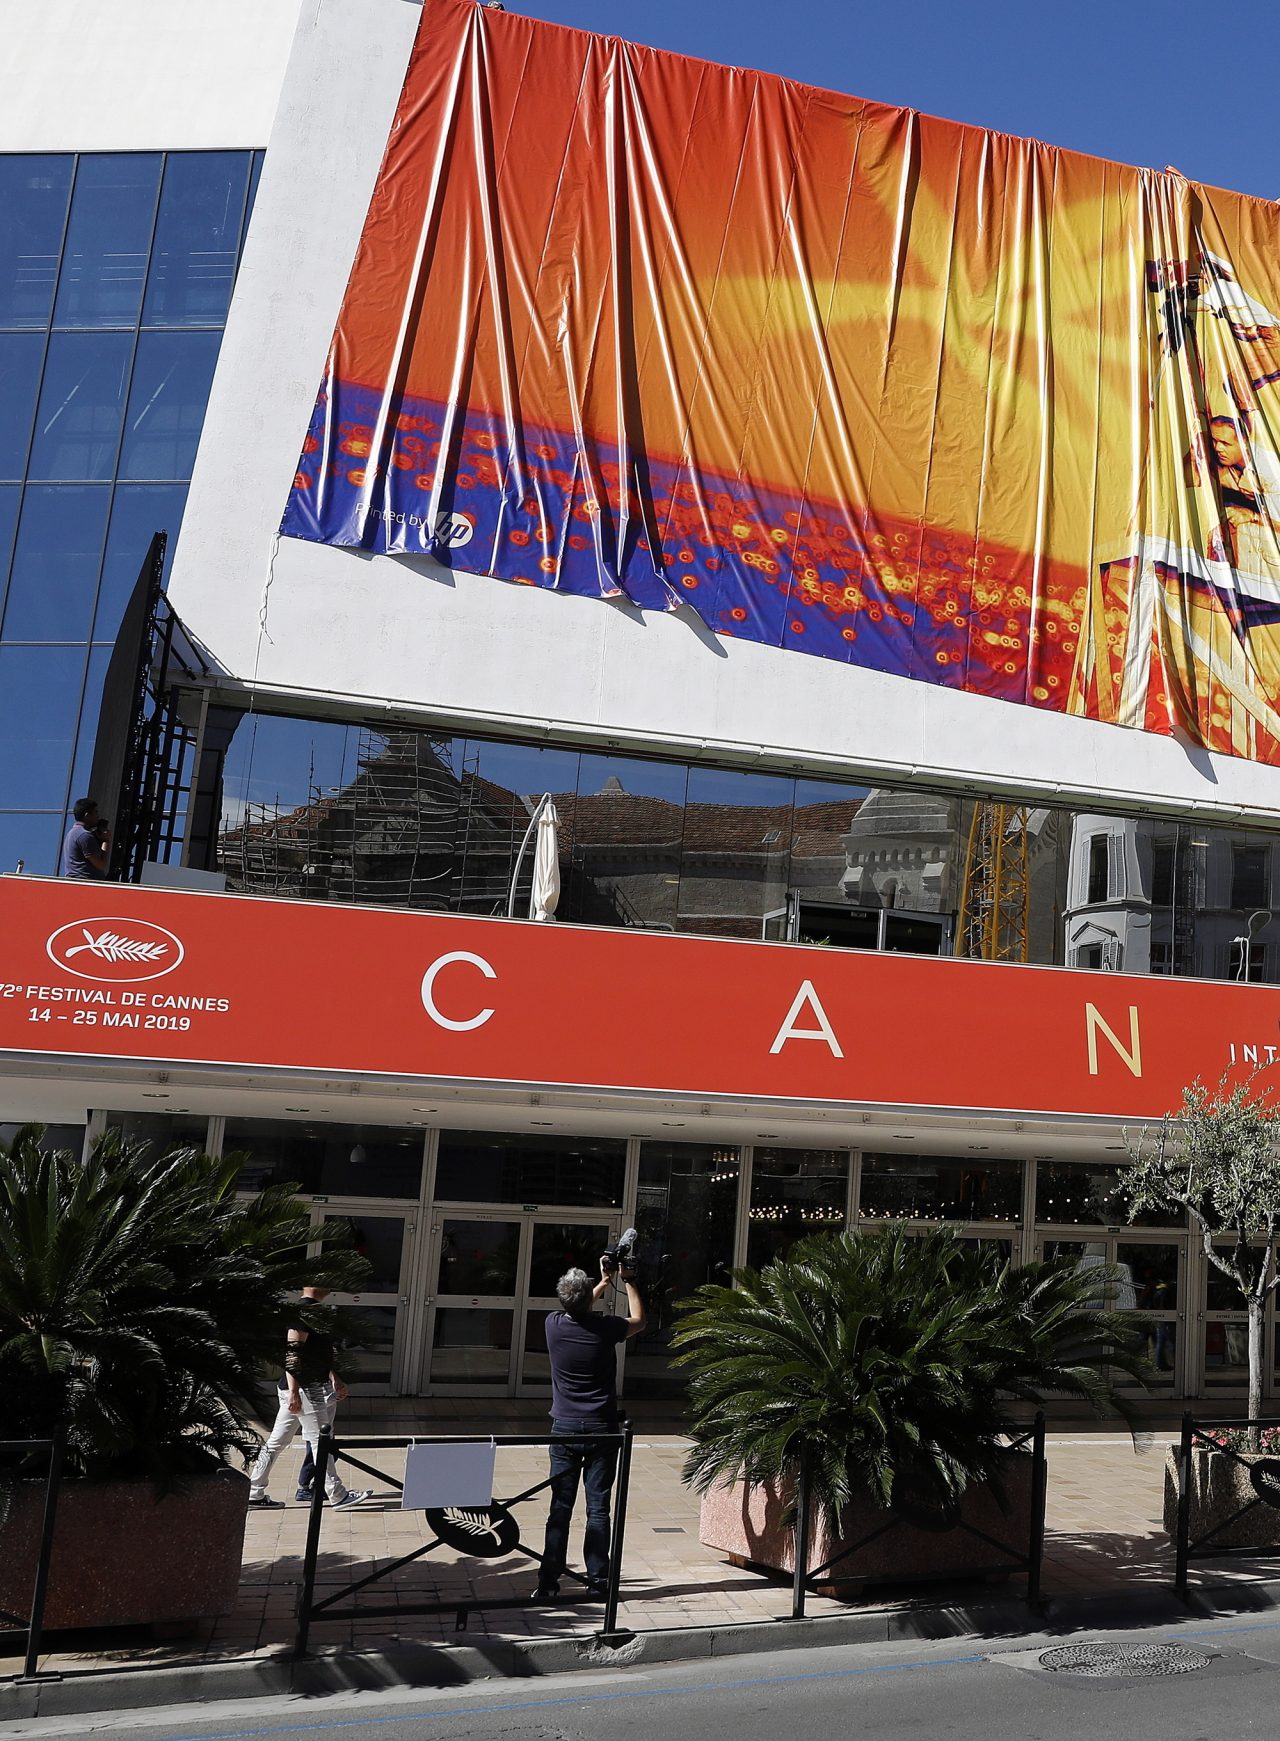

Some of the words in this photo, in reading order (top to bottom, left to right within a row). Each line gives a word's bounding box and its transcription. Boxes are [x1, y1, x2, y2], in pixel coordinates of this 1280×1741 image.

[355, 502, 406, 524] Pinted
[408, 513, 428, 529] by
[26, 985, 116, 1005] FESTIVAL
[121, 992, 146, 1007] DE
[151, 994, 230, 1012] CANNES
[28, 1007, 51, 1022] 14
[73, 1010, 98, 1025] 25
[103, 1012, 139, 1028] MAI
[144, 1015, 191, 1031] 2019
